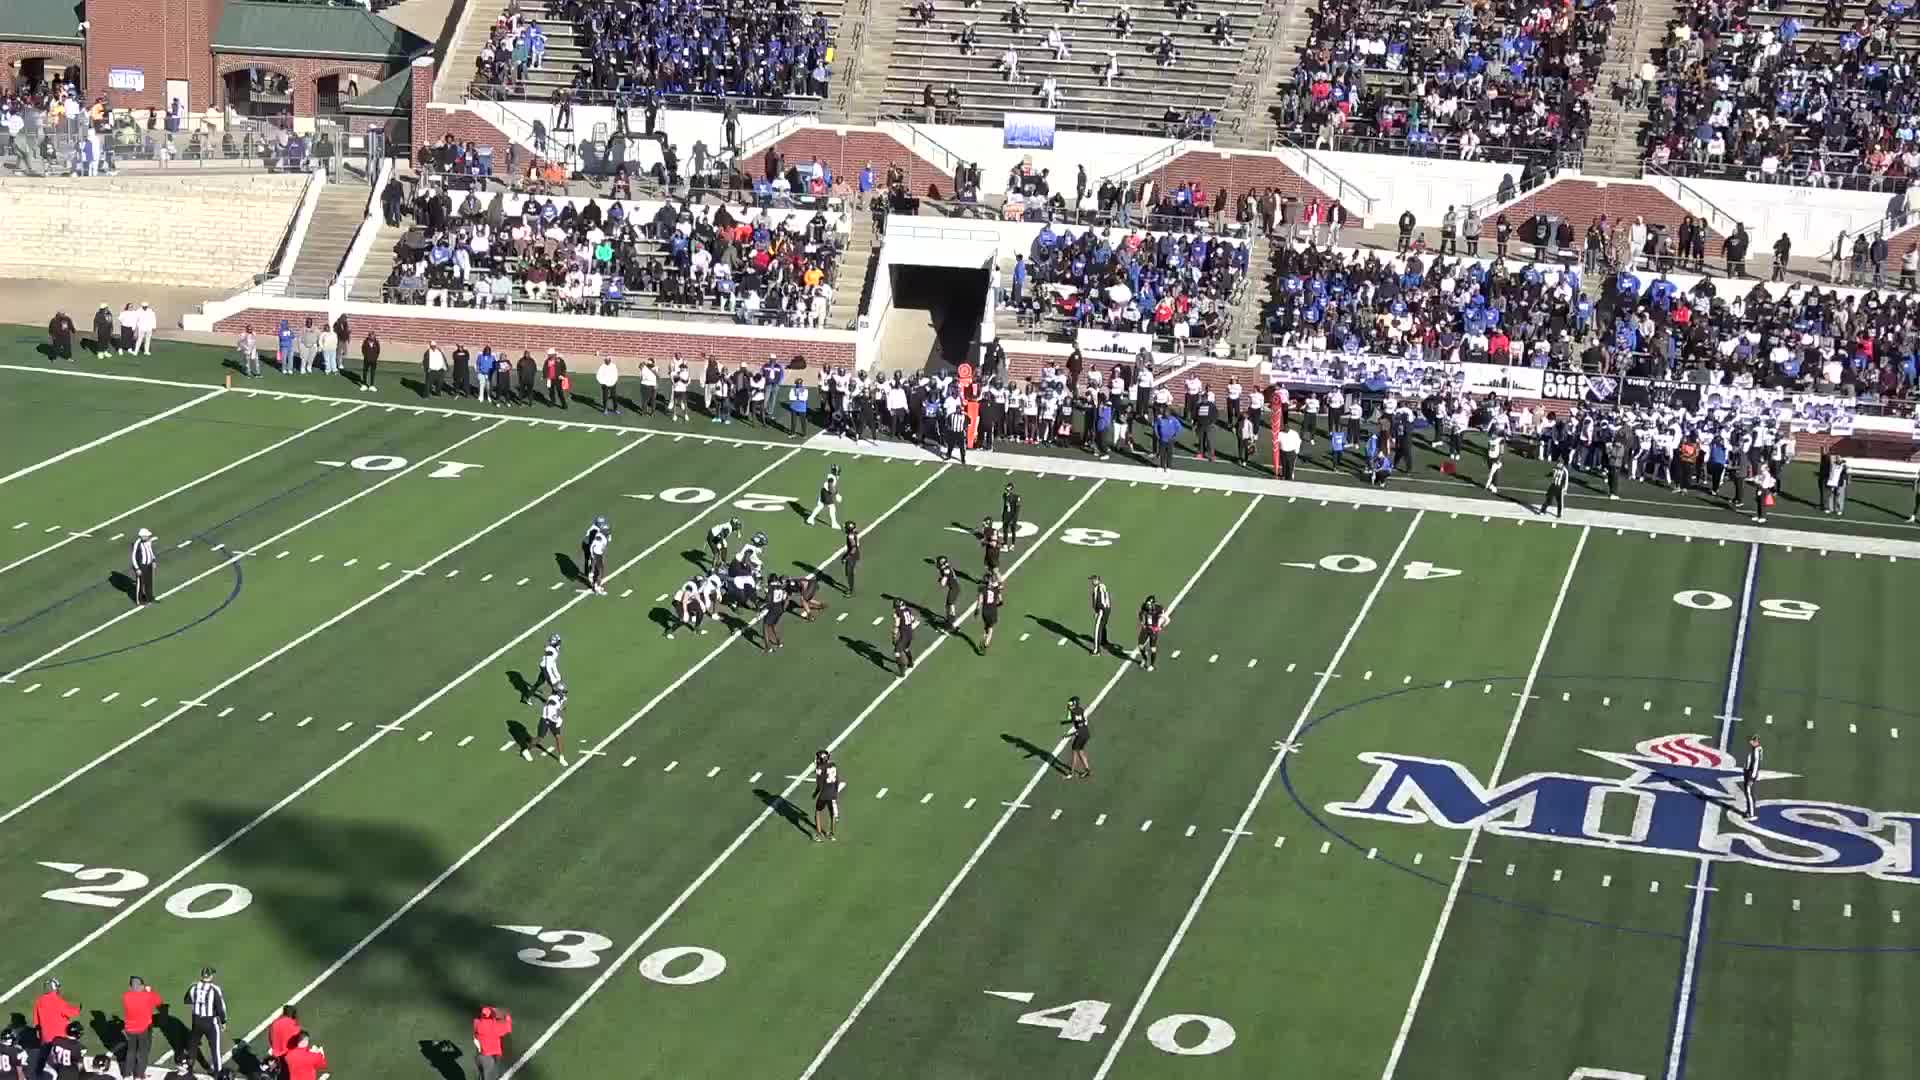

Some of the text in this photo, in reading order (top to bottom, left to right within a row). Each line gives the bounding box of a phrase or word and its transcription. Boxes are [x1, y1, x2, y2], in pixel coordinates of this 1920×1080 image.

[1545, 372, 1586, 385] DOGS
[1627, 378, 1697, 391] THEY NOT LIKE
[1544, 383, 1590, 400] ONLY
[55, 1045, 72, 1066] 78
